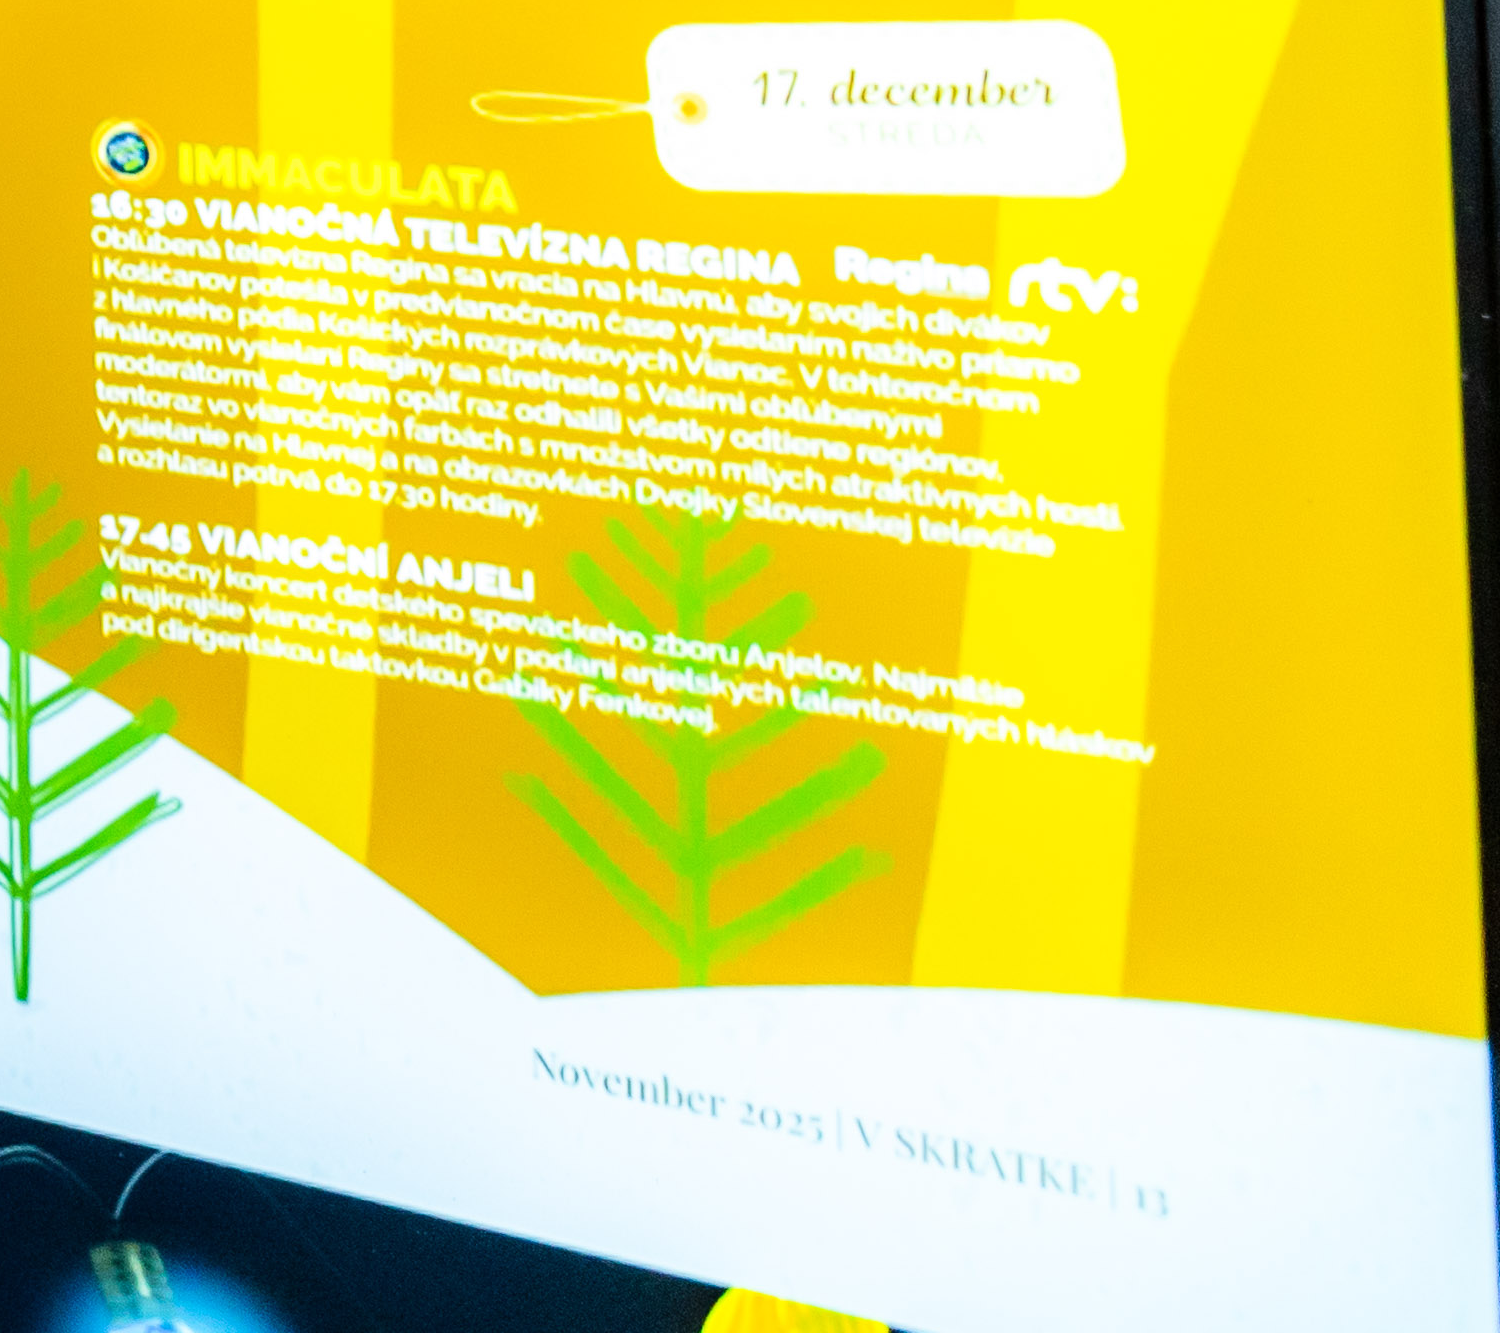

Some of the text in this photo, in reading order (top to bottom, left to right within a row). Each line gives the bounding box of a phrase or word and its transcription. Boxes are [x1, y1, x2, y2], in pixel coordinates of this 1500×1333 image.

[751, 68, 1060, 109] 17. december
[178, 145, 518, 212] IMMACULATA
[90, 190, 801, 286] 16:30 VIANOČNÁ TELEVÍZNA REGINA
[834, 246, 990, 299] Regina
[99, 514, 535, 602] 17.45 VIANOČNÍ ANJELI
[532, 1047, 1169, 1218] November 2025 V SKRATKE 13
